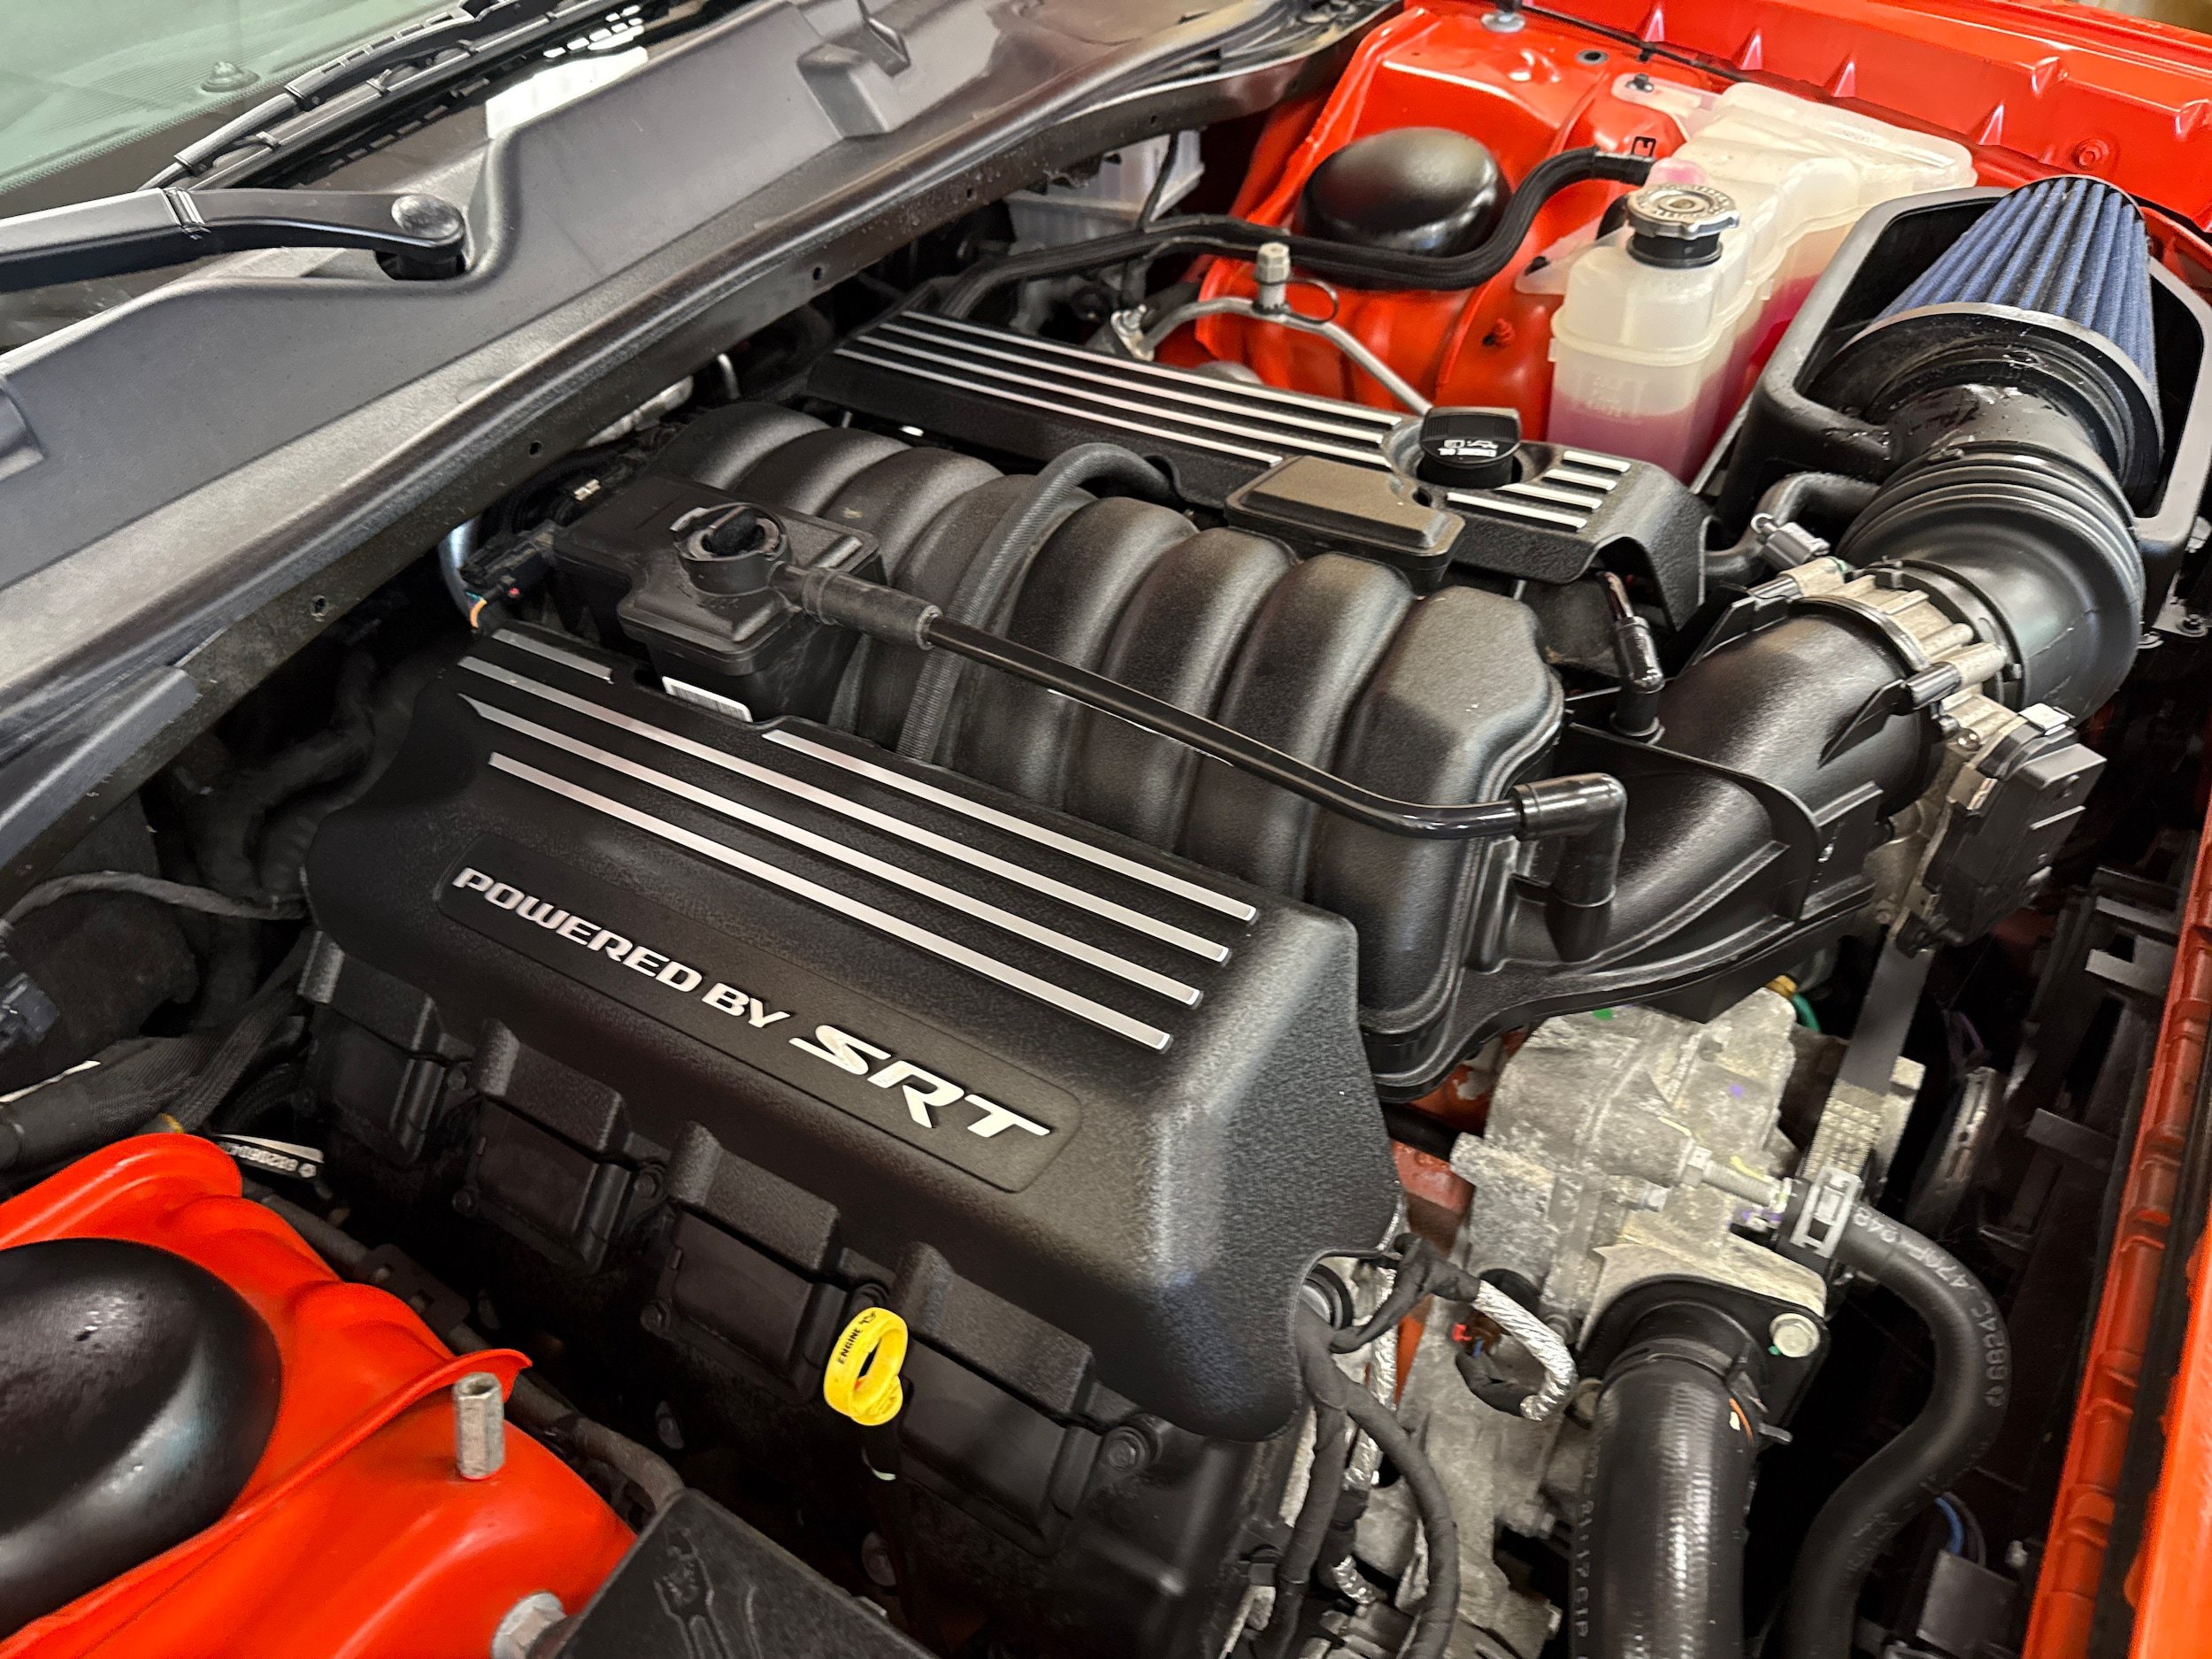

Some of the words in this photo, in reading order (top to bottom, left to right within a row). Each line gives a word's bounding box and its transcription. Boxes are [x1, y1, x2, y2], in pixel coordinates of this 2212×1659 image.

[451, 866, 703, 993] POWERED
[701, 982, 791, 1028] BY
[788, 1025, 1051, 1138] SRT
[835, 1329, 862, 1365] ENGINE
